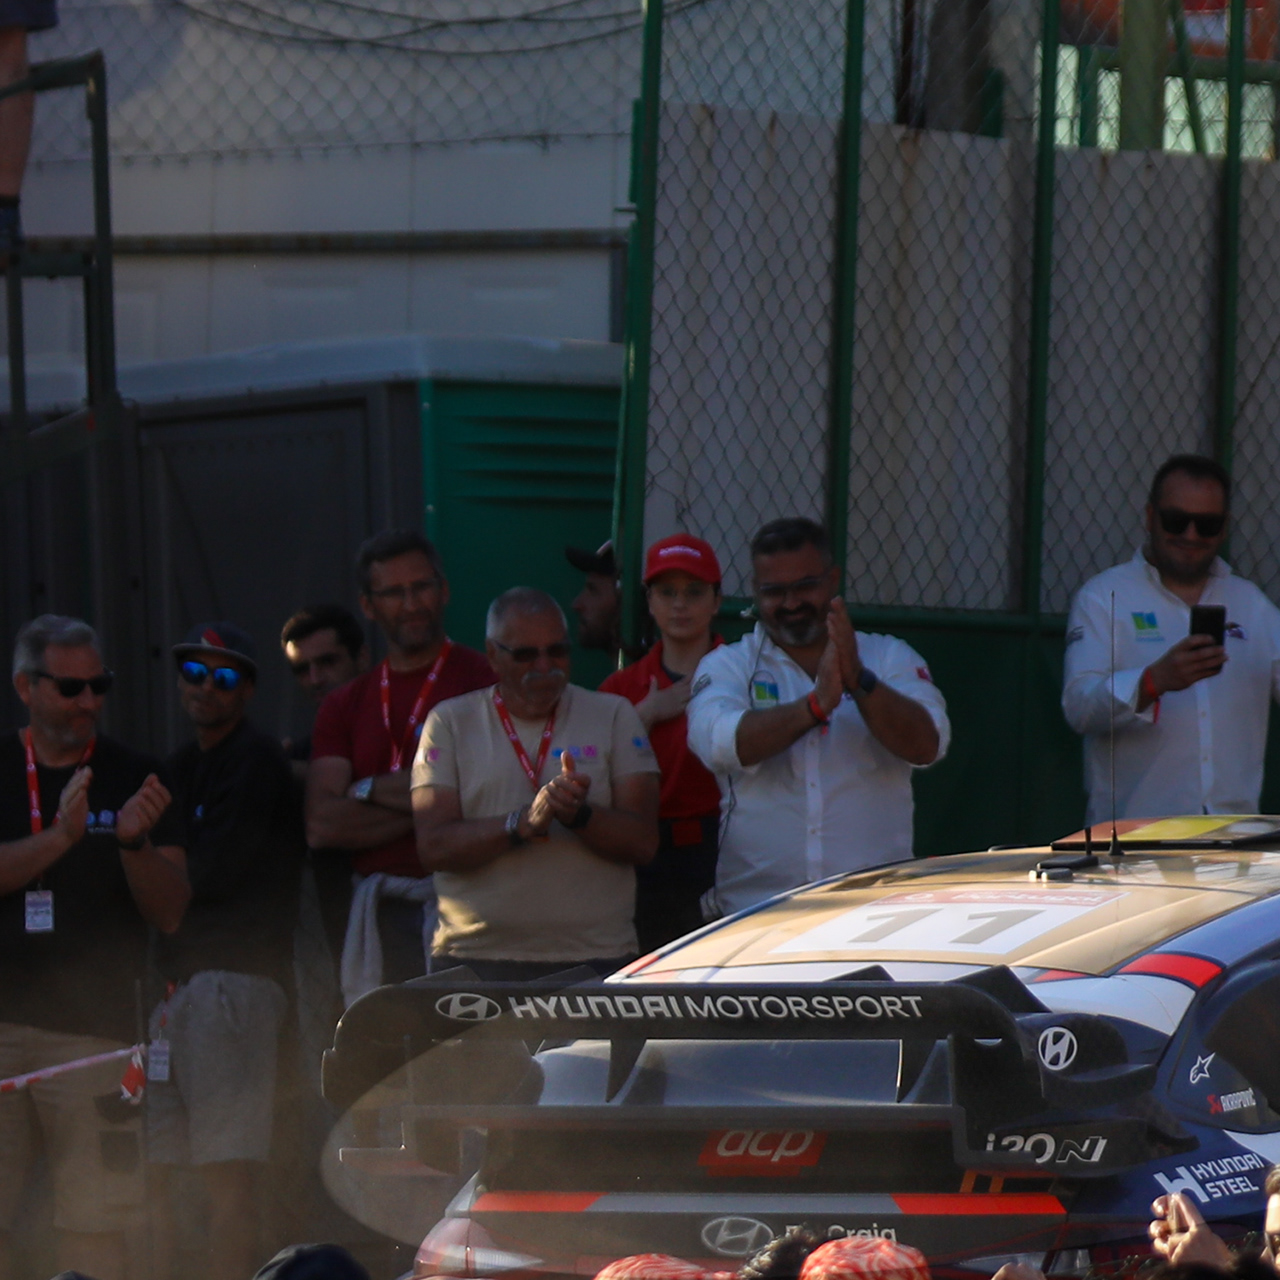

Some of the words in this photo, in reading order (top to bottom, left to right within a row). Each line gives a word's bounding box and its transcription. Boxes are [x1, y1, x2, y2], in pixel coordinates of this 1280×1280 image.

[847, 907, 1046, 945] 11
[513, 995, 681, 1020] HYUNDAI
[683, 995, 923, 1019] MOTORSPORT
[716, 1129, 815, 1163] acp
[1193, 1152, 1265, 1180] HYUNDAI
[1205, 1174, 1260, 1199] STEEL
